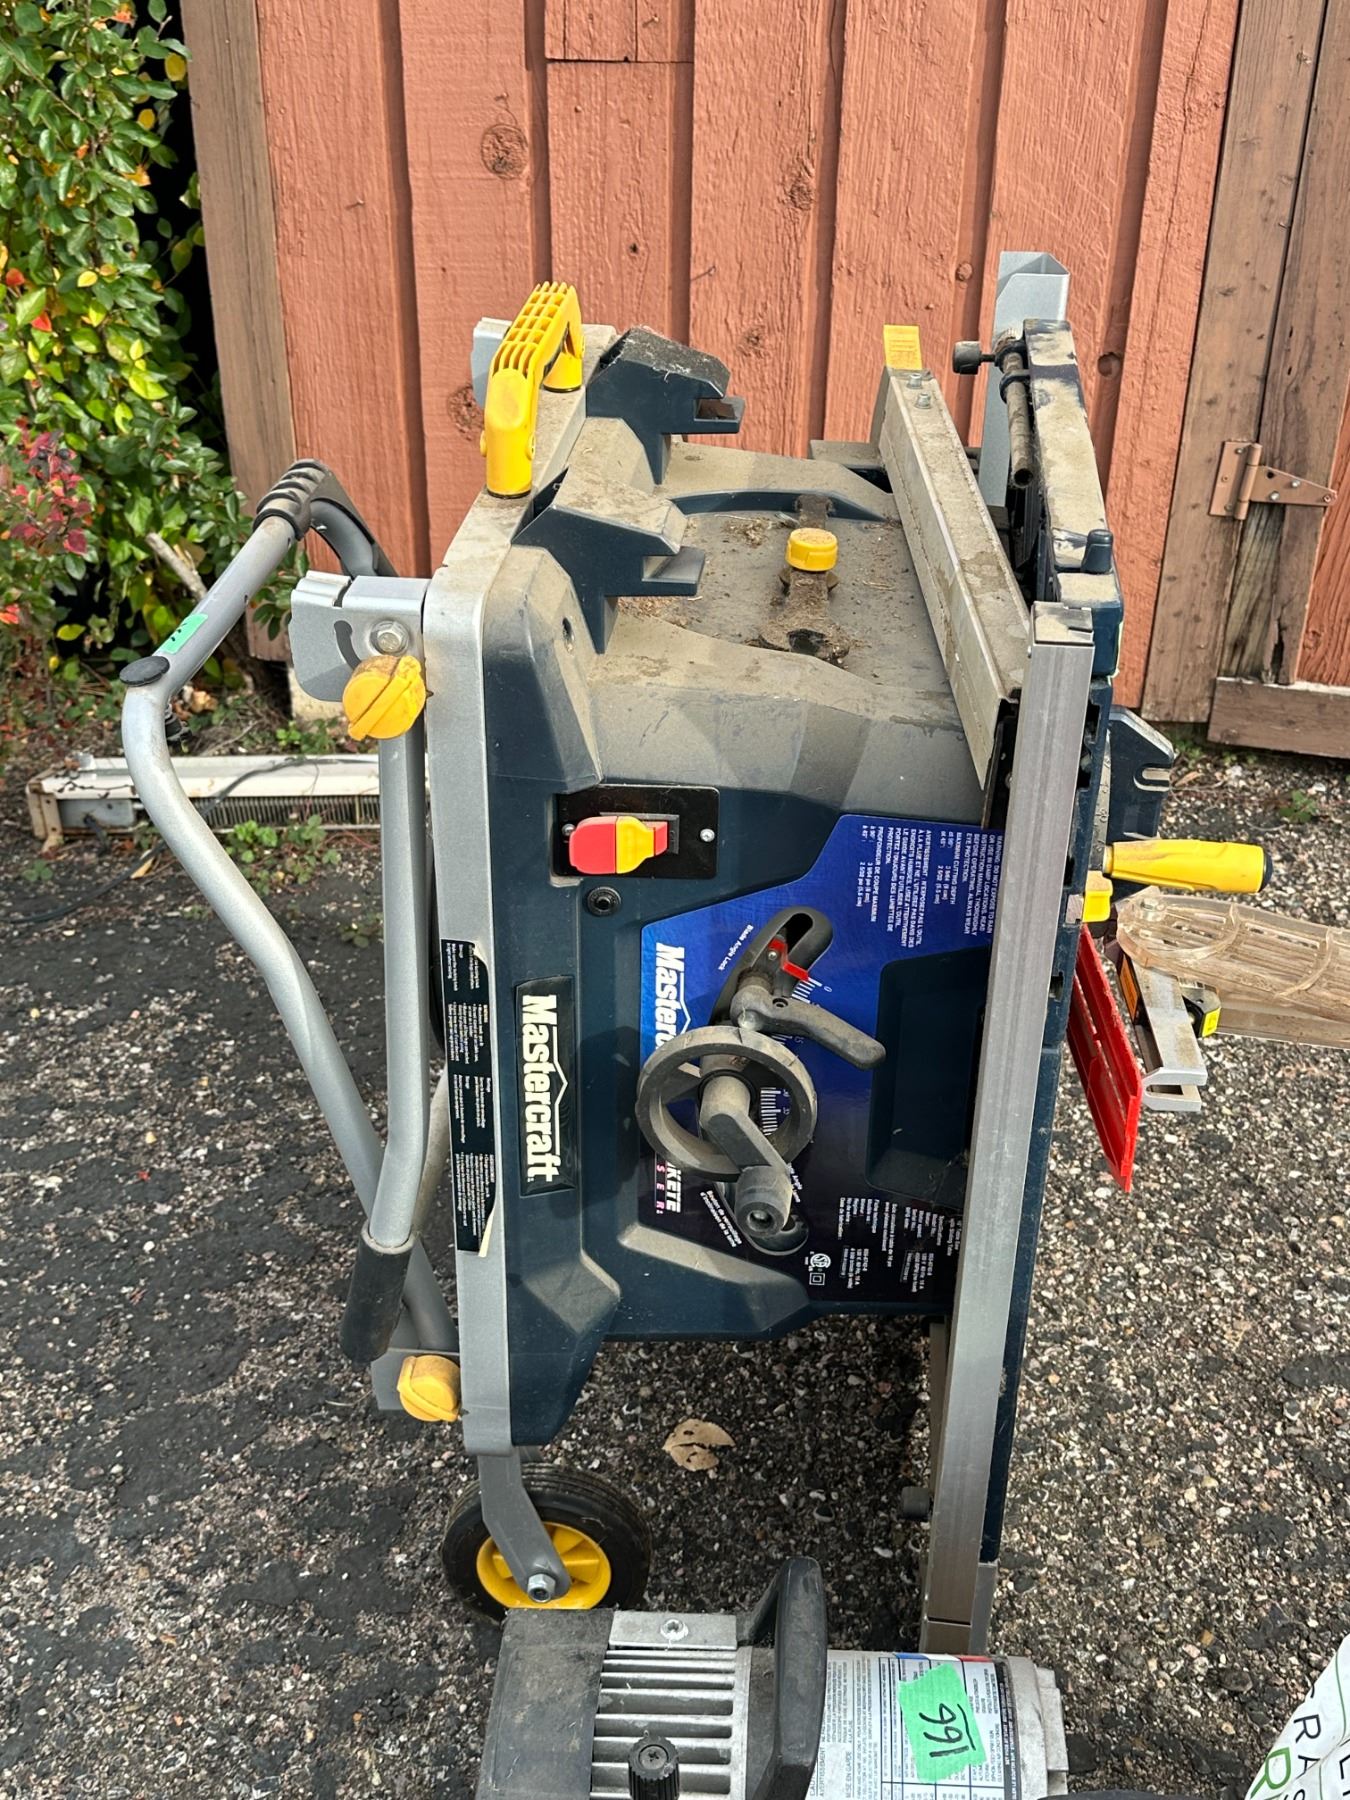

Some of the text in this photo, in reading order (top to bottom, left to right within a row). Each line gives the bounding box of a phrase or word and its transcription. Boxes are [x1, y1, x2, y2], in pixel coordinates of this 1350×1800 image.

[903, 828, 908, 836] LE
[989, 835, 995, 843] OR
[979, 834, 987, 872] INSTRUCTION
[874, 866, 880, 874] DE
[993, 865, 999, 873] DO
[975, 873, 983, 896] MANUAL
[988, 911, 994, 919] TO
[887, 924, 893, 932] DE
[717, 924, 754, 971] Blade Angle Lock
[655, 942, 685, 1048] Masterc
[522, 994, 561, 1182] Mastercraft
[666, 1161, 681, 1212] KEYE
[919, 1703, 969, 1757] 166
